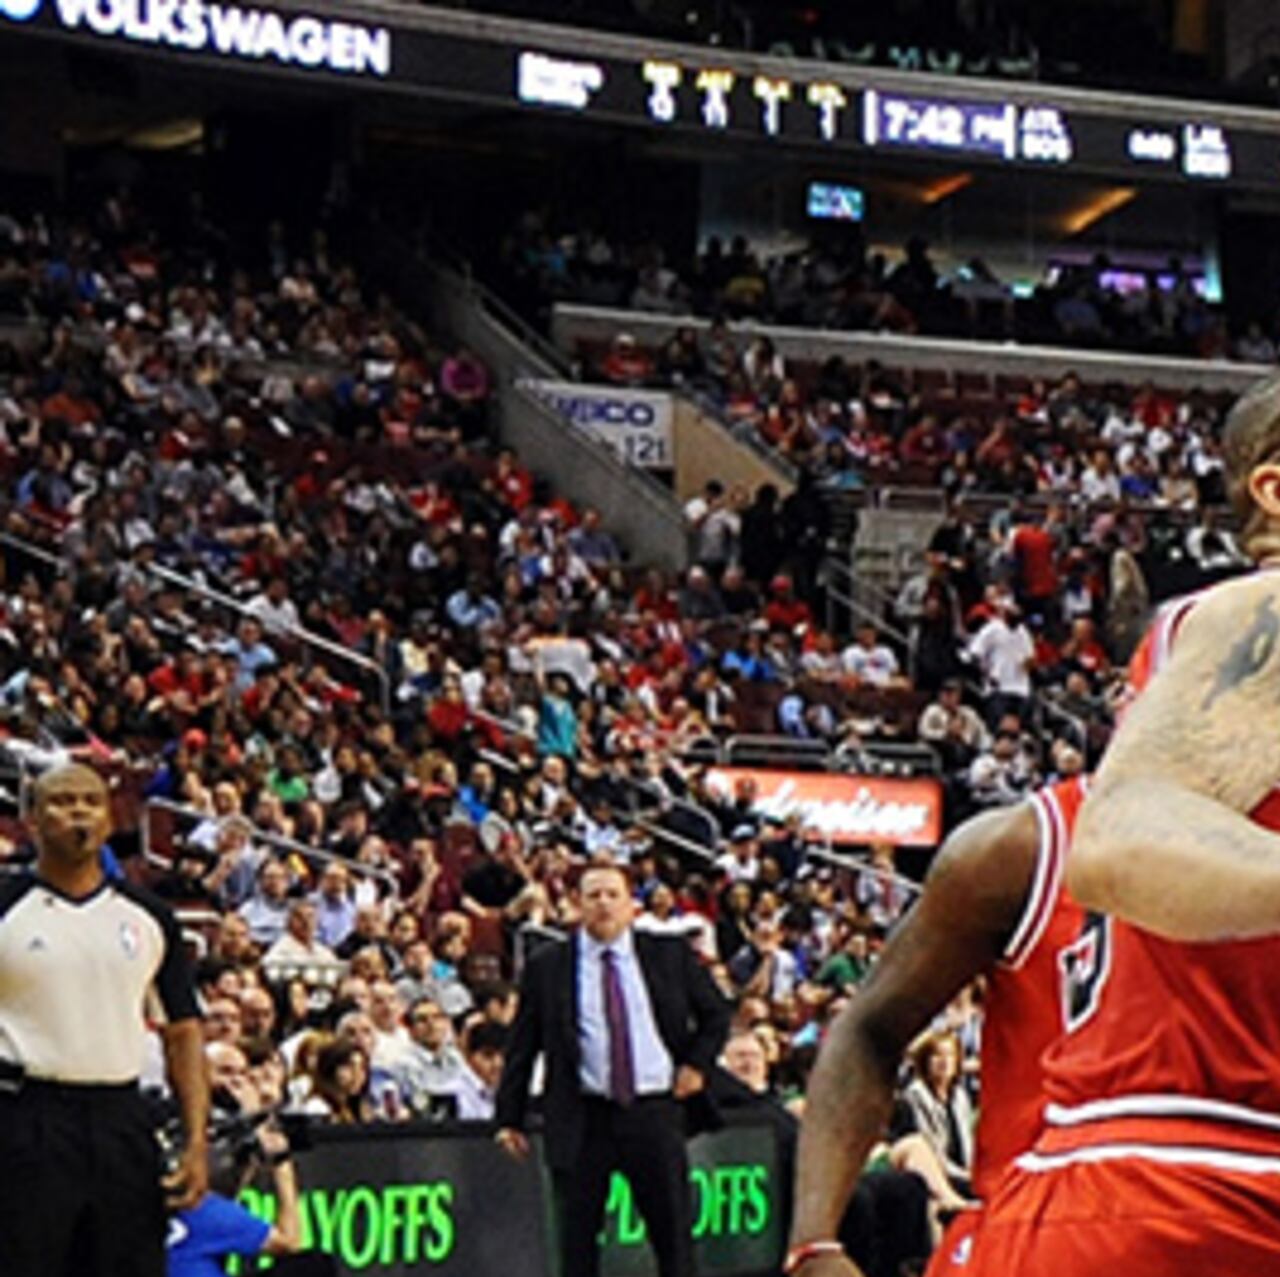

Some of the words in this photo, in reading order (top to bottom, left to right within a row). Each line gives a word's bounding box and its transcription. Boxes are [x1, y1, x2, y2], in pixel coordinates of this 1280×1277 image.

[57, 0, 391, 75] VOLKSWAGEN
[884, 101, 962, 146] 7:42
[705, 768, 929, 835] dweiser
[226, 1183, 454, 1277] YOFFS
[596, 1164, 769, 1244] LOFFS
